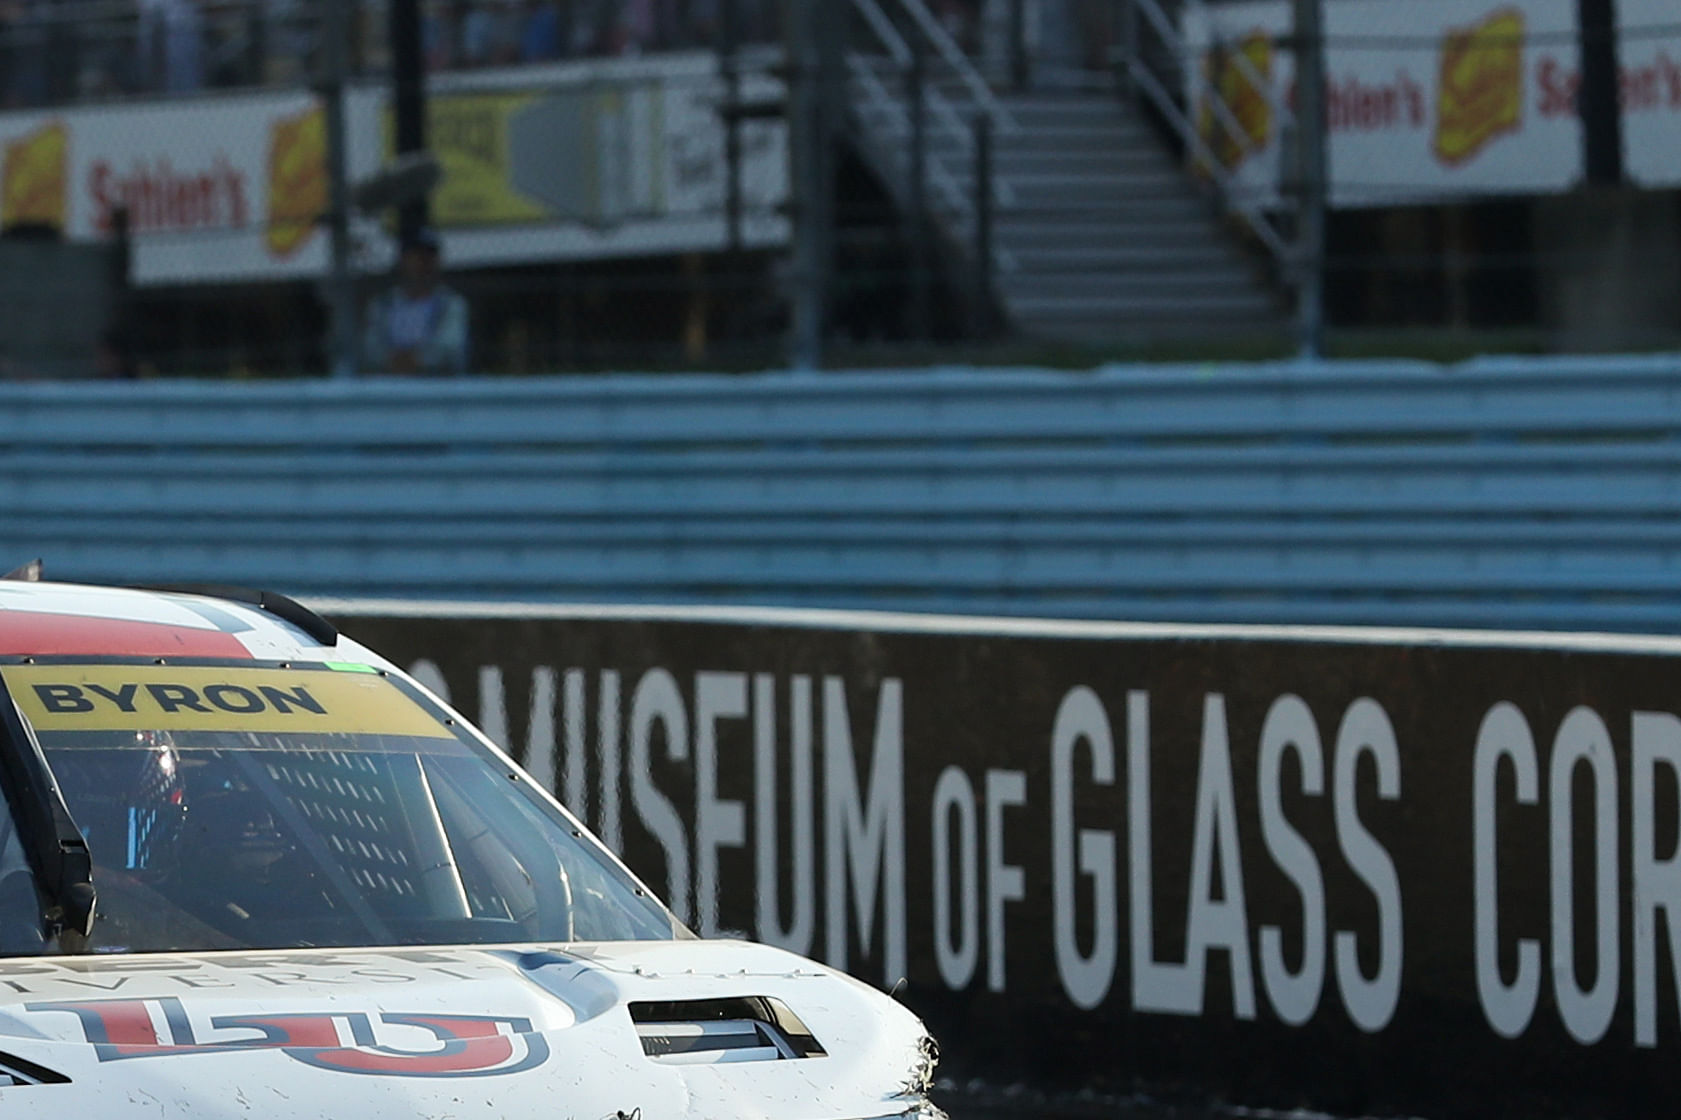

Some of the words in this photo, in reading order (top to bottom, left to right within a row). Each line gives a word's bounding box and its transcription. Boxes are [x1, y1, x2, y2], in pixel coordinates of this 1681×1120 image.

[32, 683, 328, 715] BYRON
[932, 766, 1027, 993] OF
[1051, 685, 1404, 1033] GLASS
[1473, 701, 1681, 1048] COR
